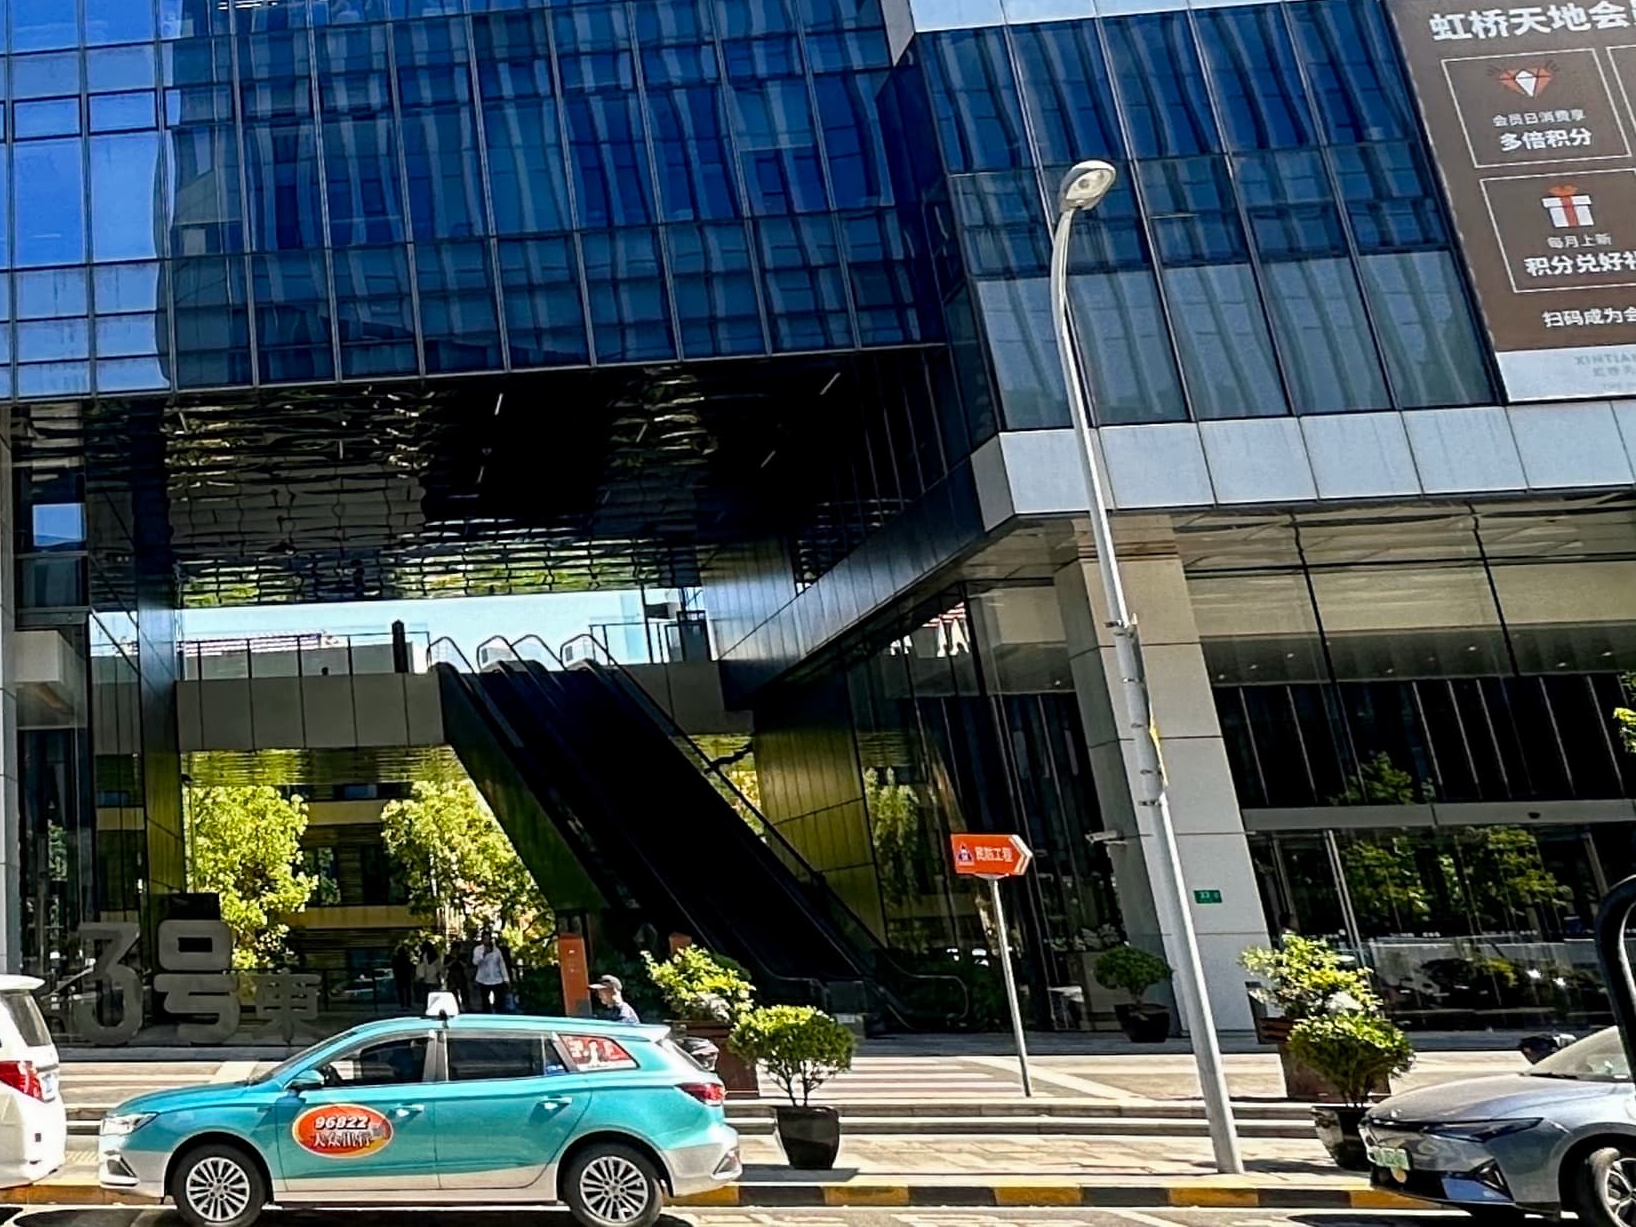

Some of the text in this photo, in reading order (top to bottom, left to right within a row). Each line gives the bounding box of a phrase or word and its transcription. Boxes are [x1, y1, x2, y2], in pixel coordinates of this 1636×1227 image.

[1429, 0, 1636, 41] 虹桥天地会
[1500, 128, 1592, 152] 多倍积分
[1548, 233, 1612, 249] 每月上新
[315, 1115, 370, 1130] 96822
